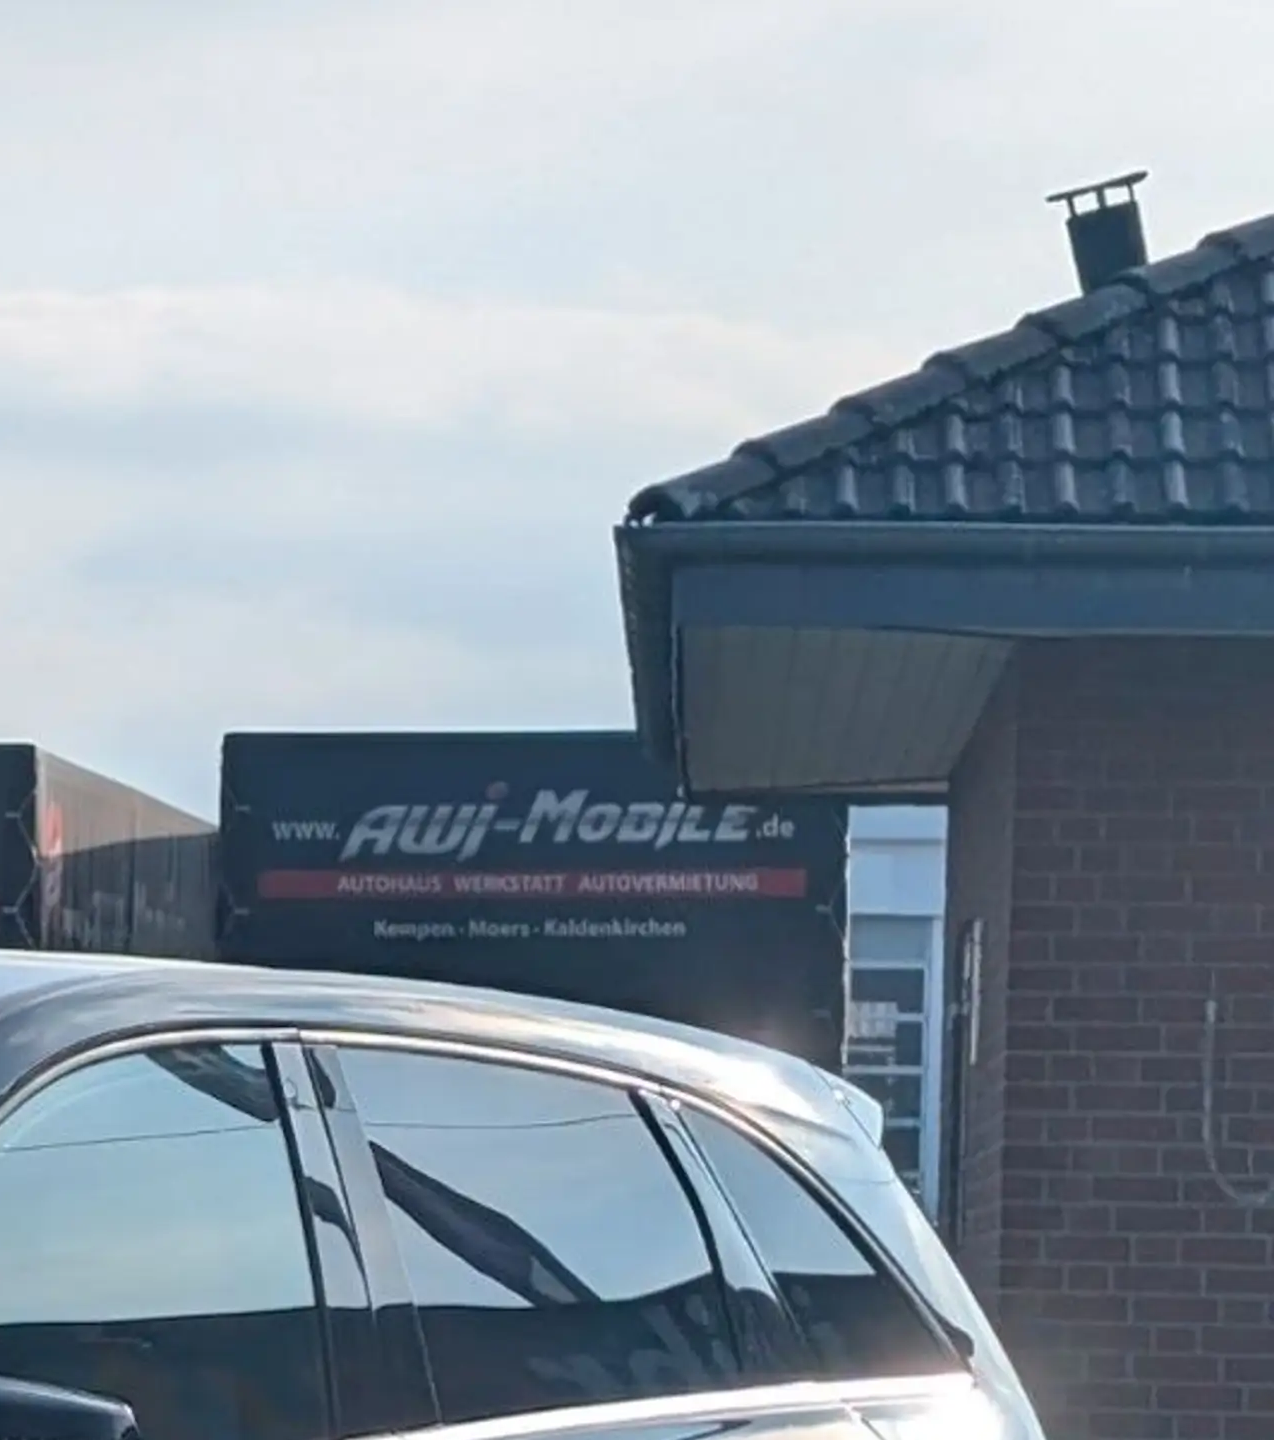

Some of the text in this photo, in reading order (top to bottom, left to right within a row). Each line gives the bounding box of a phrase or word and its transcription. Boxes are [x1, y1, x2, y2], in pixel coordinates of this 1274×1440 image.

[337, 872, 759, 894] AUTOHAUS WERKSTATT AUTOVERMIETUNG
[373, 916, 688, 941] Kempen Moers Kaldenkirchen
